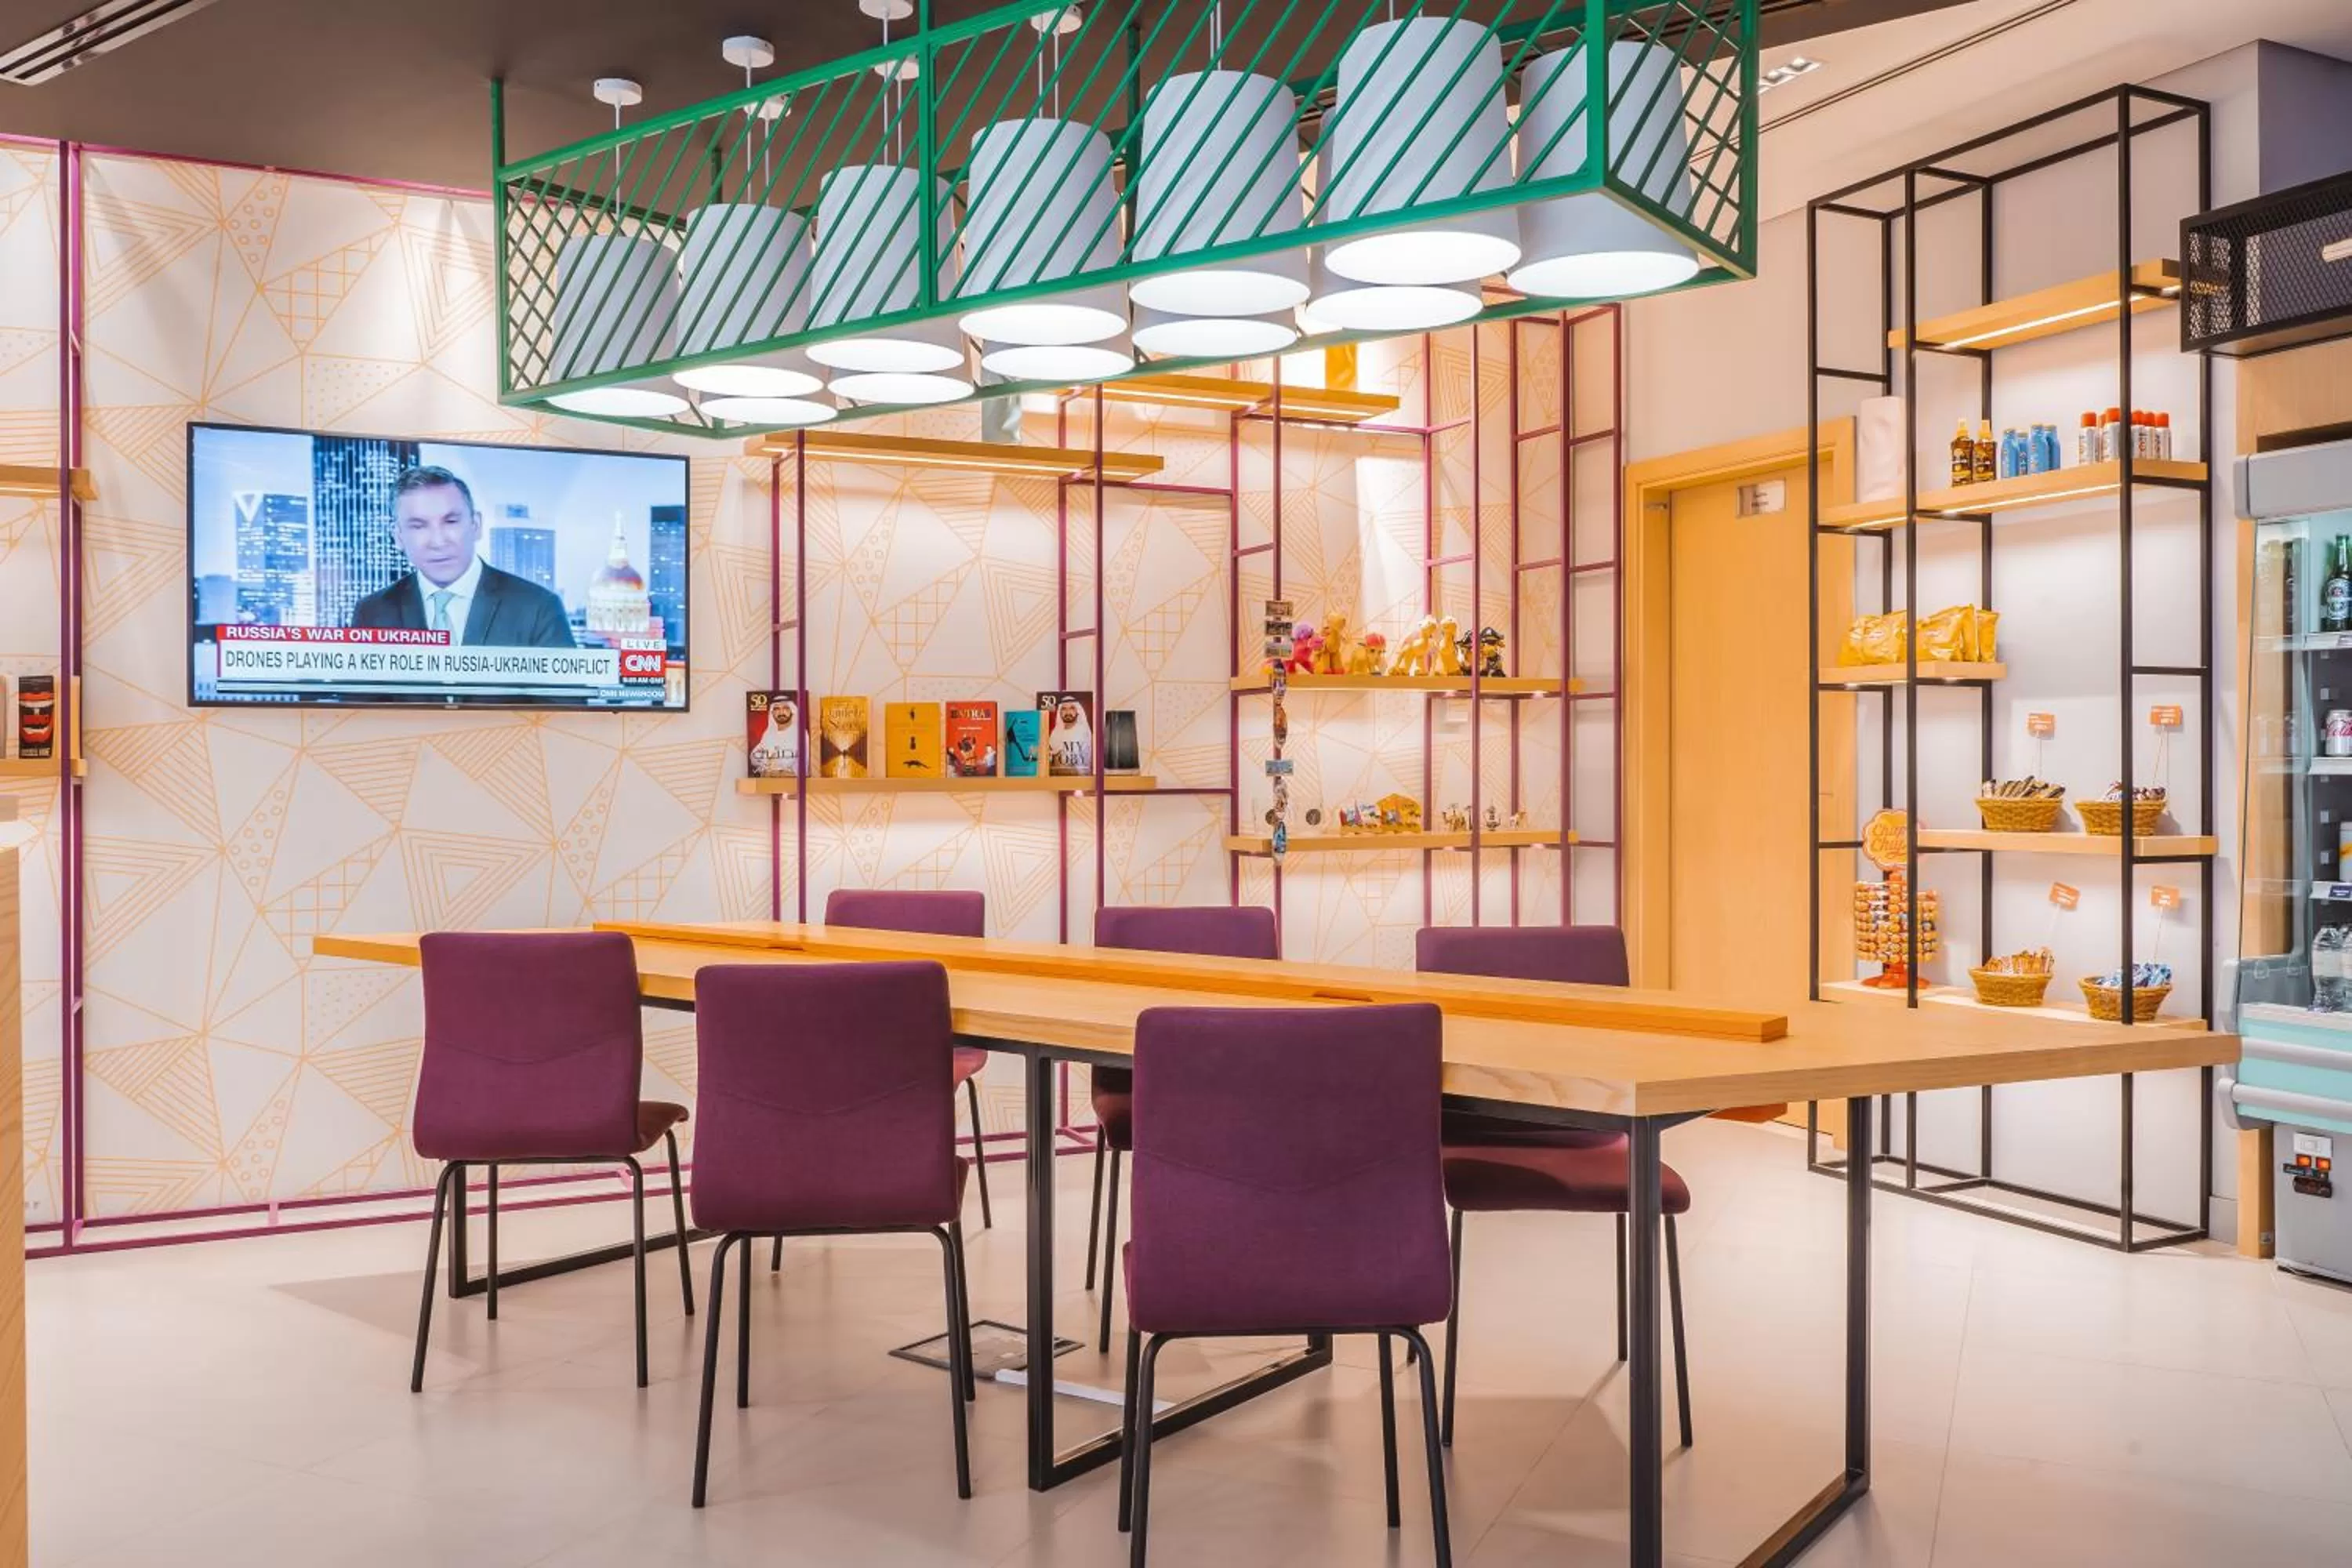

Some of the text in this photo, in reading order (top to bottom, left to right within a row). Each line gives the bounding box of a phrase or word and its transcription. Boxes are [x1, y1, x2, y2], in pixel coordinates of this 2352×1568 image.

[226, 626, 448, 644] RUSSIA'S WAR ON UKRAINE
[626, 640, 661, 648] LIVE
[225, 650, 611, 675] DRONES PLAYING A KEY ROLE IN RUSSIA-UKRAINE CONFLICT
[625, 655, 662, 672] CNN
[1872, 824, 1907, 839] Chup
